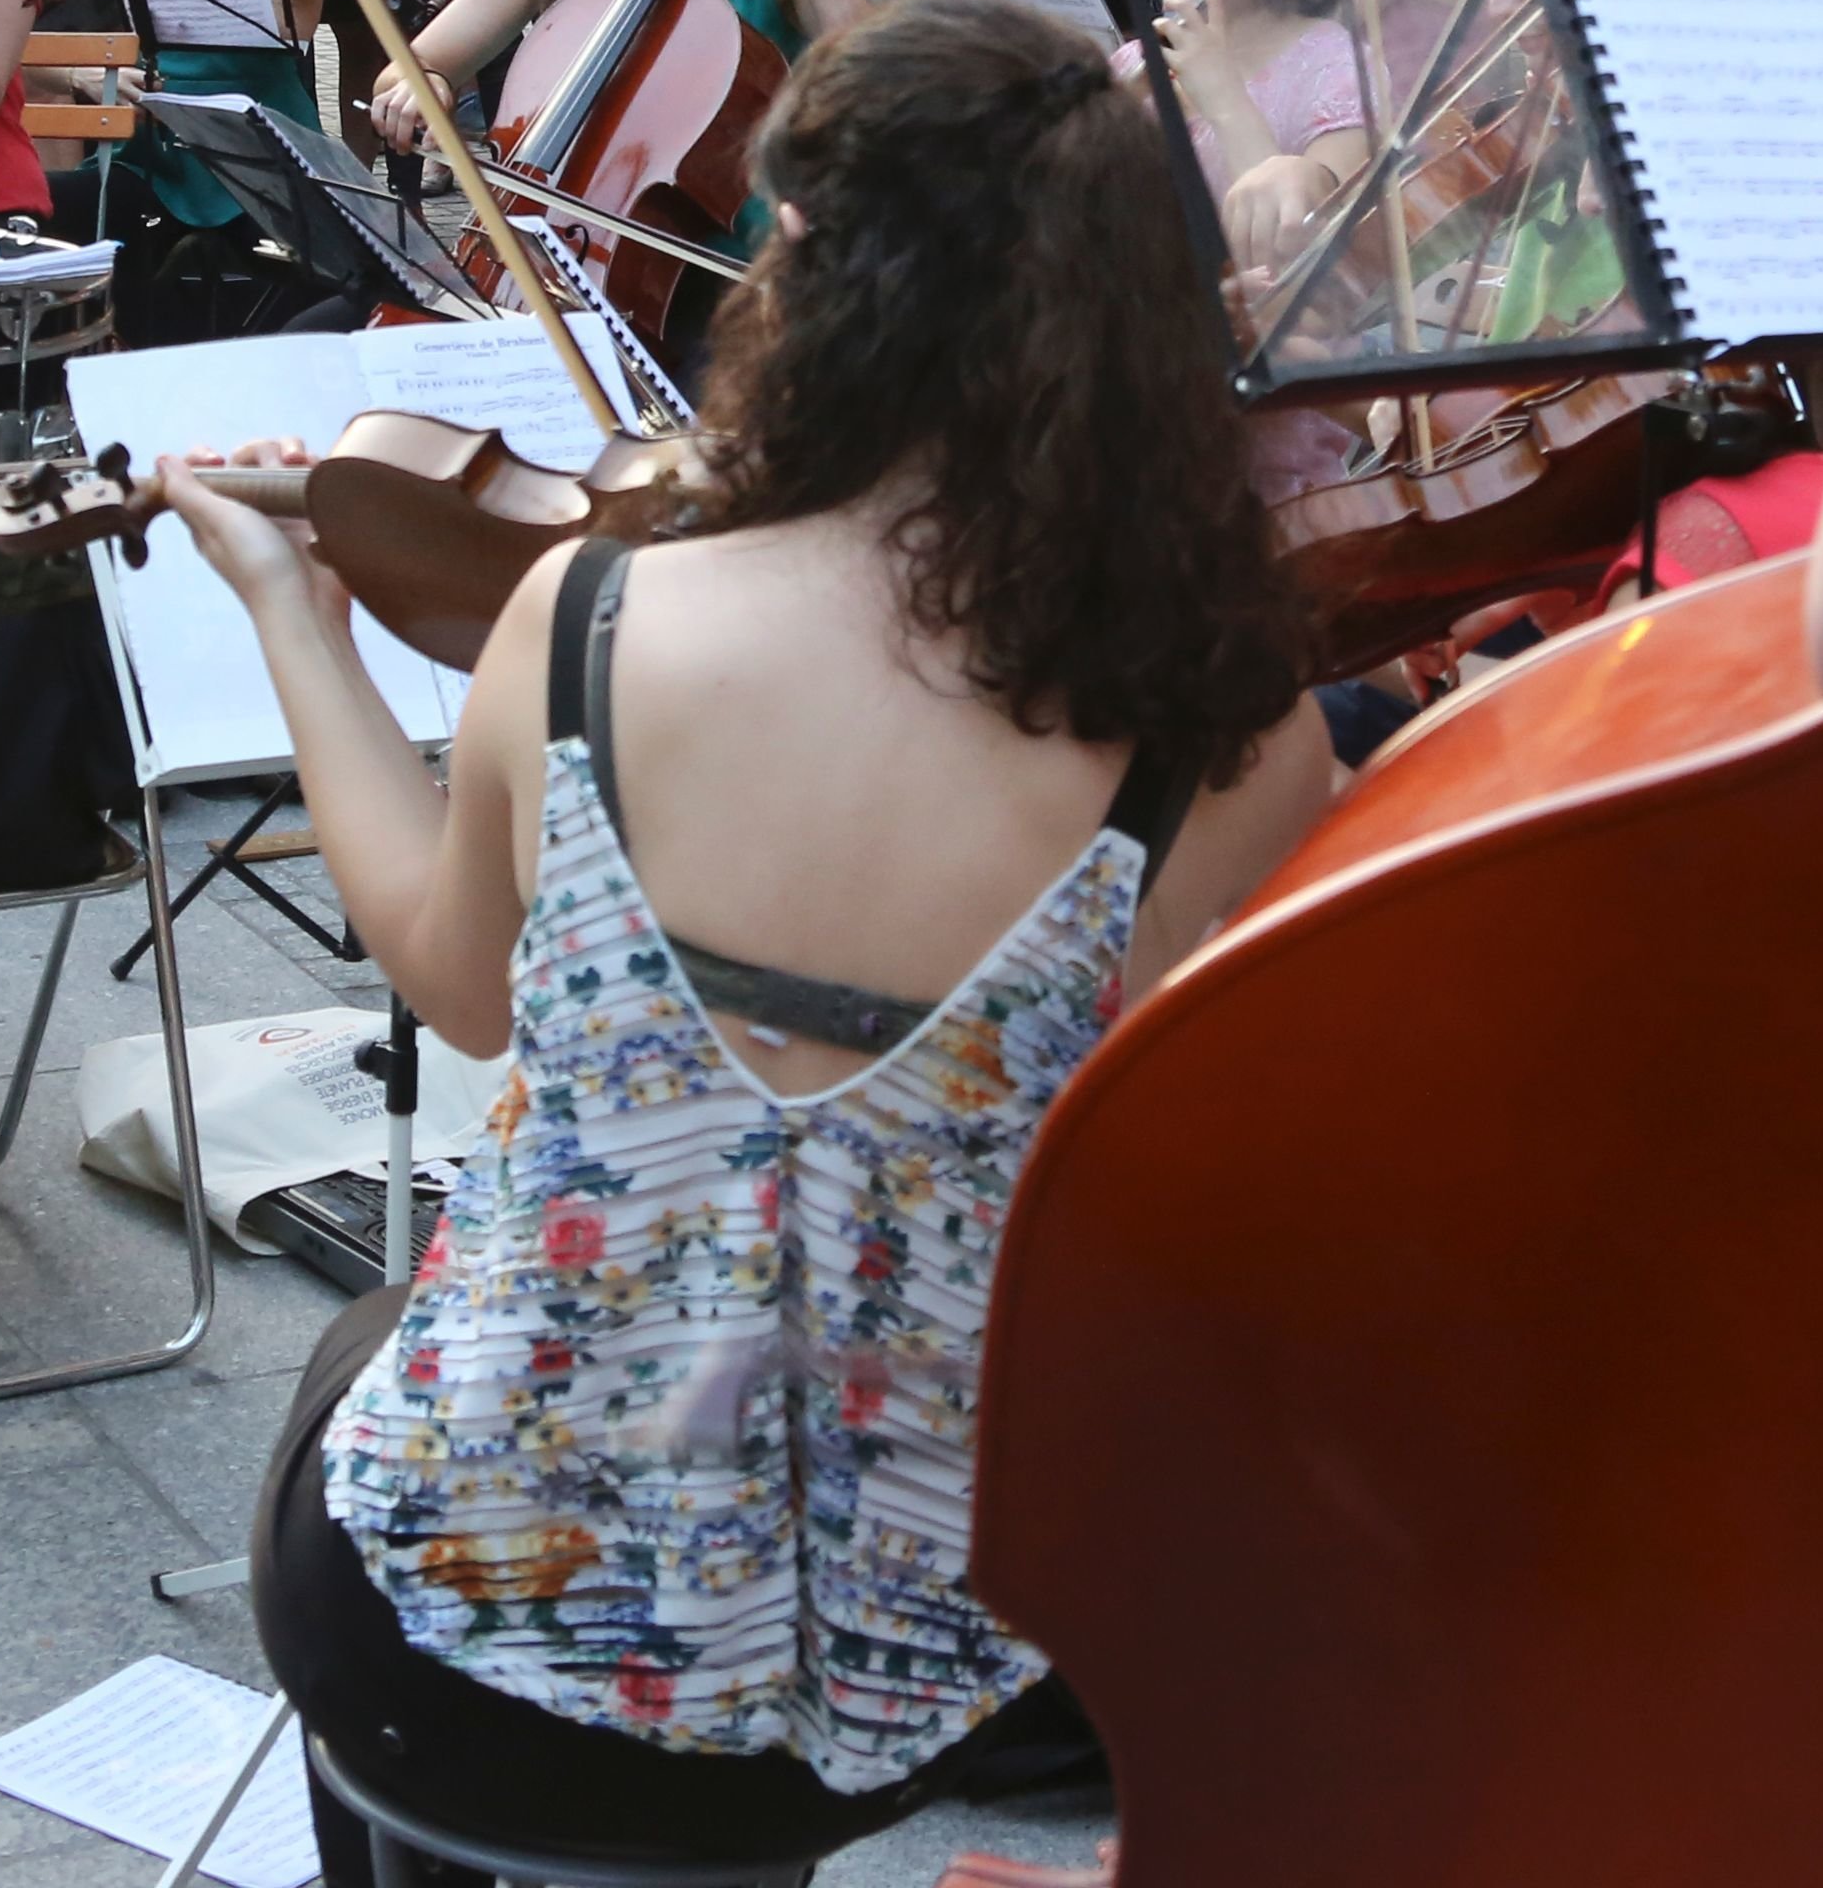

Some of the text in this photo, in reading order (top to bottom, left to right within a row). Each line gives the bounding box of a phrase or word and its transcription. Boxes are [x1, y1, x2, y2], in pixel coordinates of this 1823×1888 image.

[479, 339, 494, 350] de
[497, 335, 547, 348] Brabant
[337, 1104, 384, 1126] MONDE
